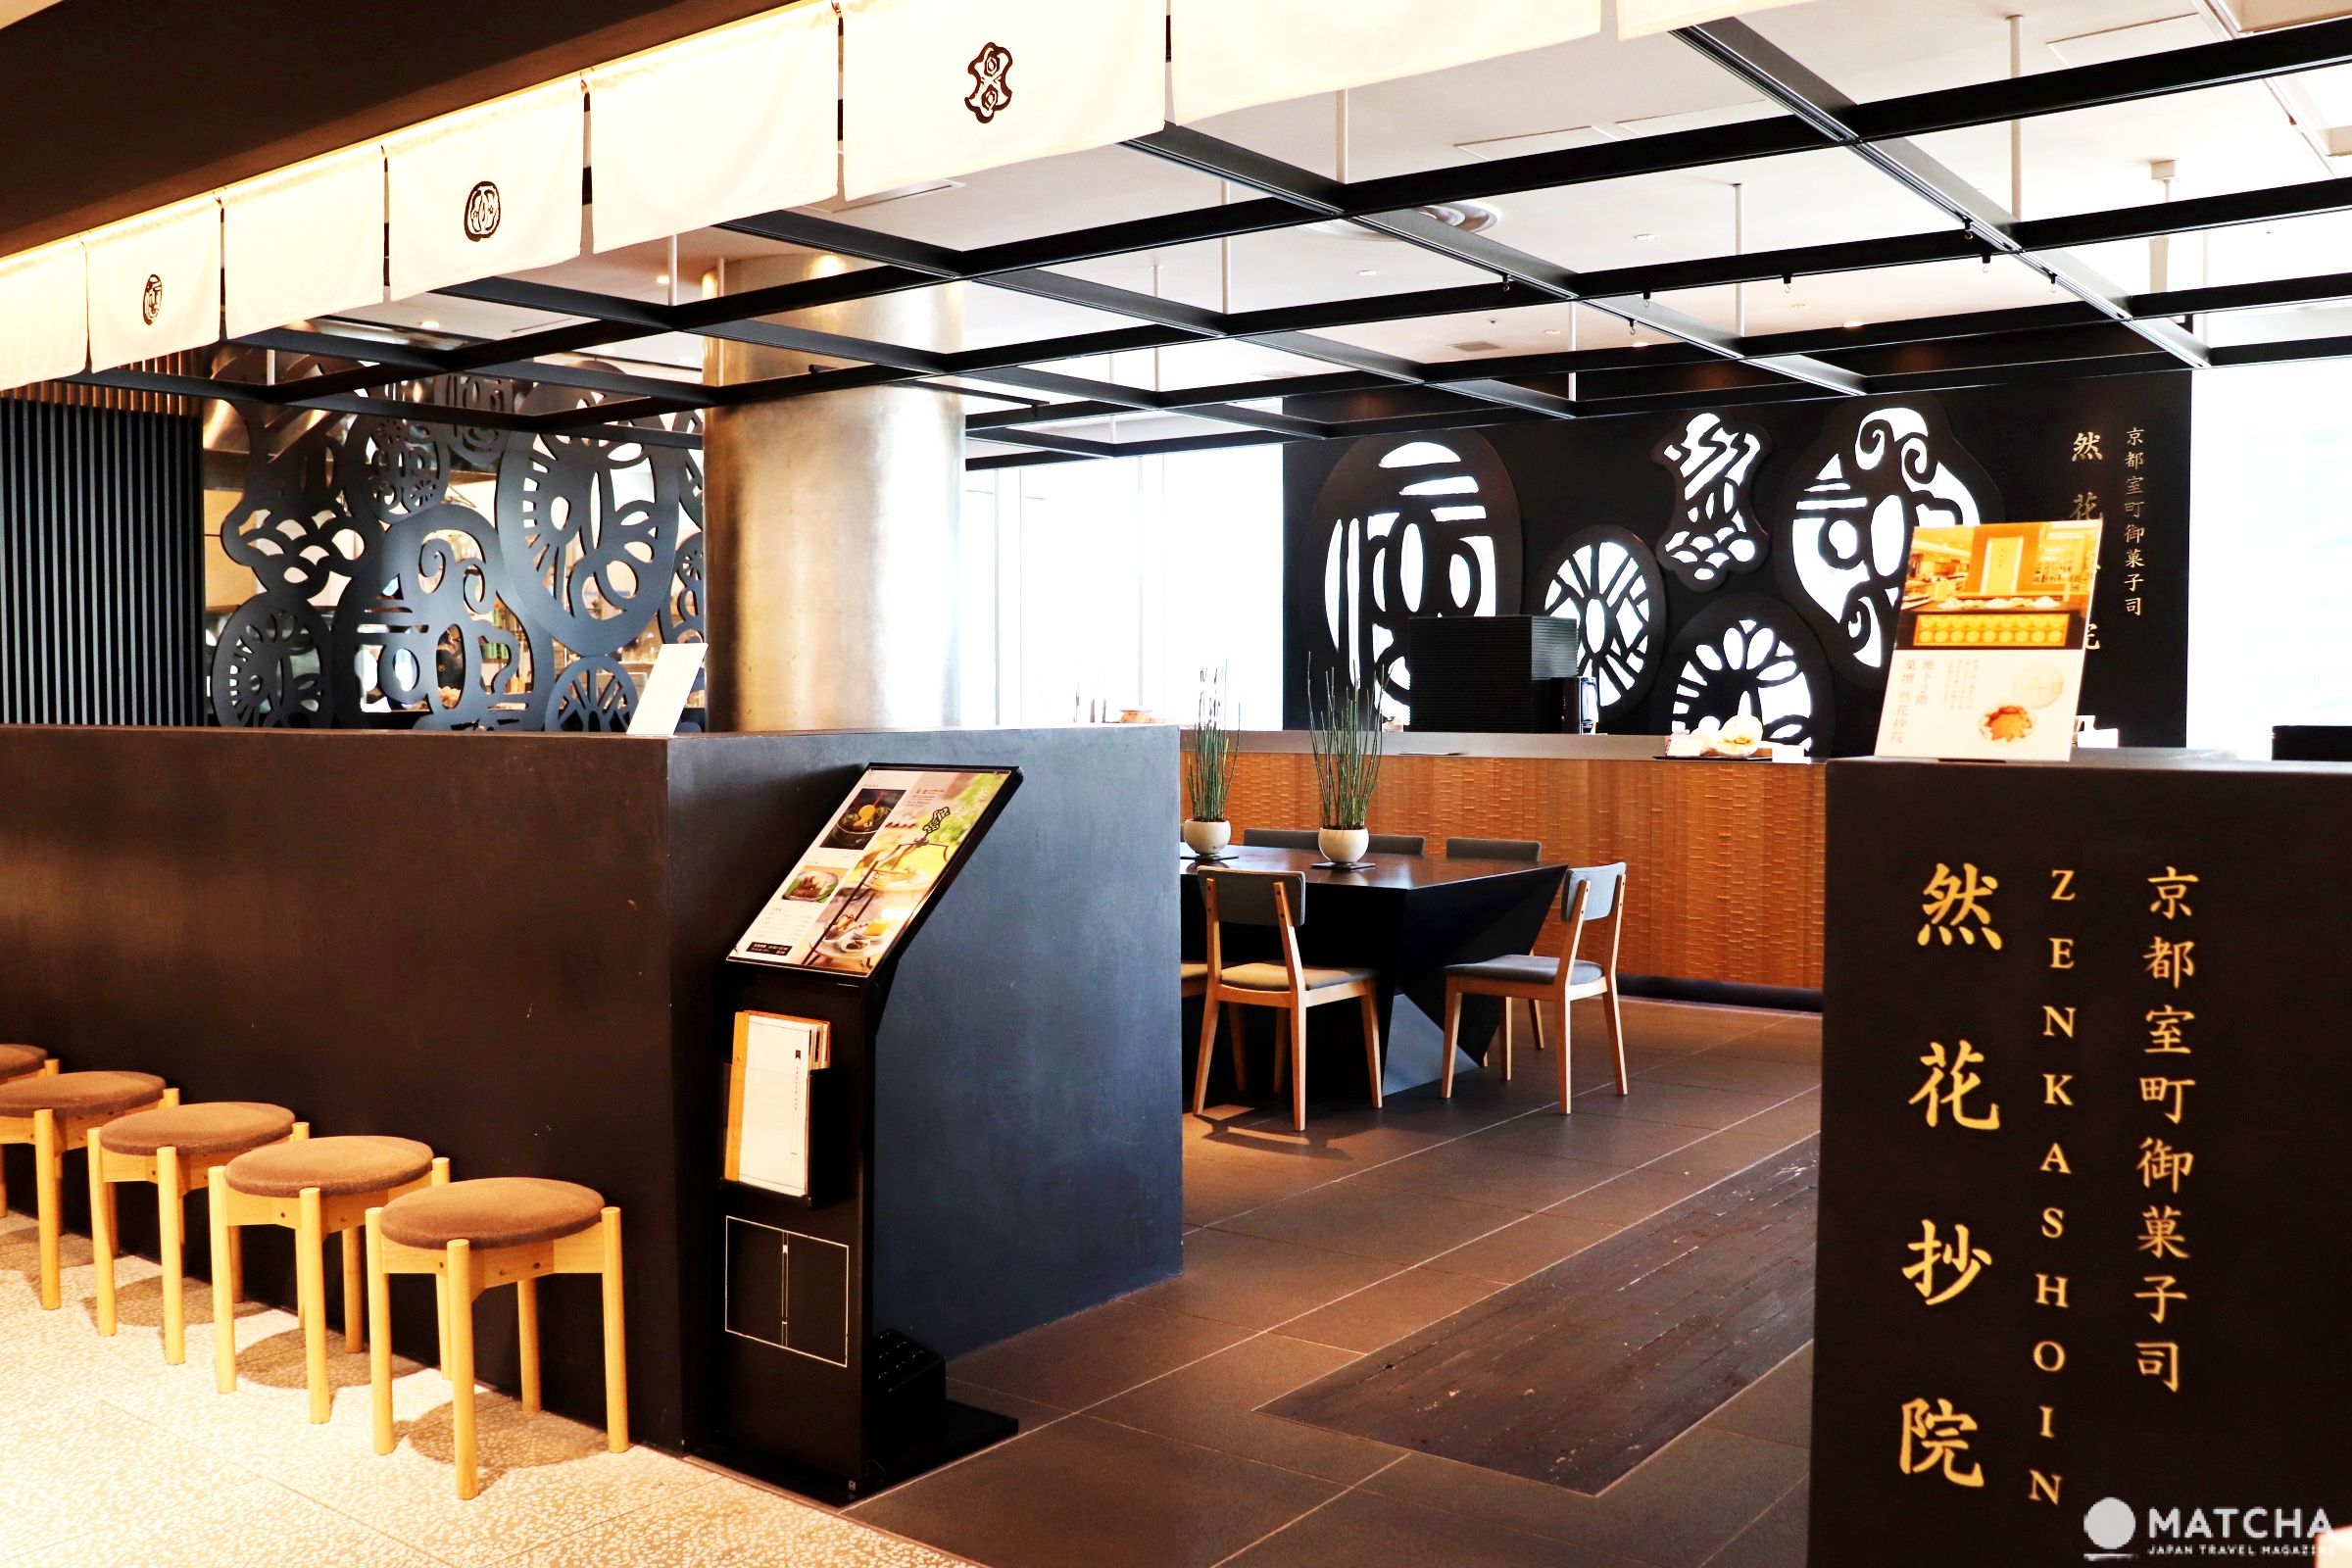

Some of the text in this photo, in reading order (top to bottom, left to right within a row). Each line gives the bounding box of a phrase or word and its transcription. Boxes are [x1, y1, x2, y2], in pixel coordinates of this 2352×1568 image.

[2124, 427, 2145, 616] 京都室町御菓子司
[1900, 863, 2002, 1488] 然花抄院
[2029, 869, 2077, 1506] ZENKASHOIN
[2134, 866, 2199, 1393] 京都室町御菓子司
